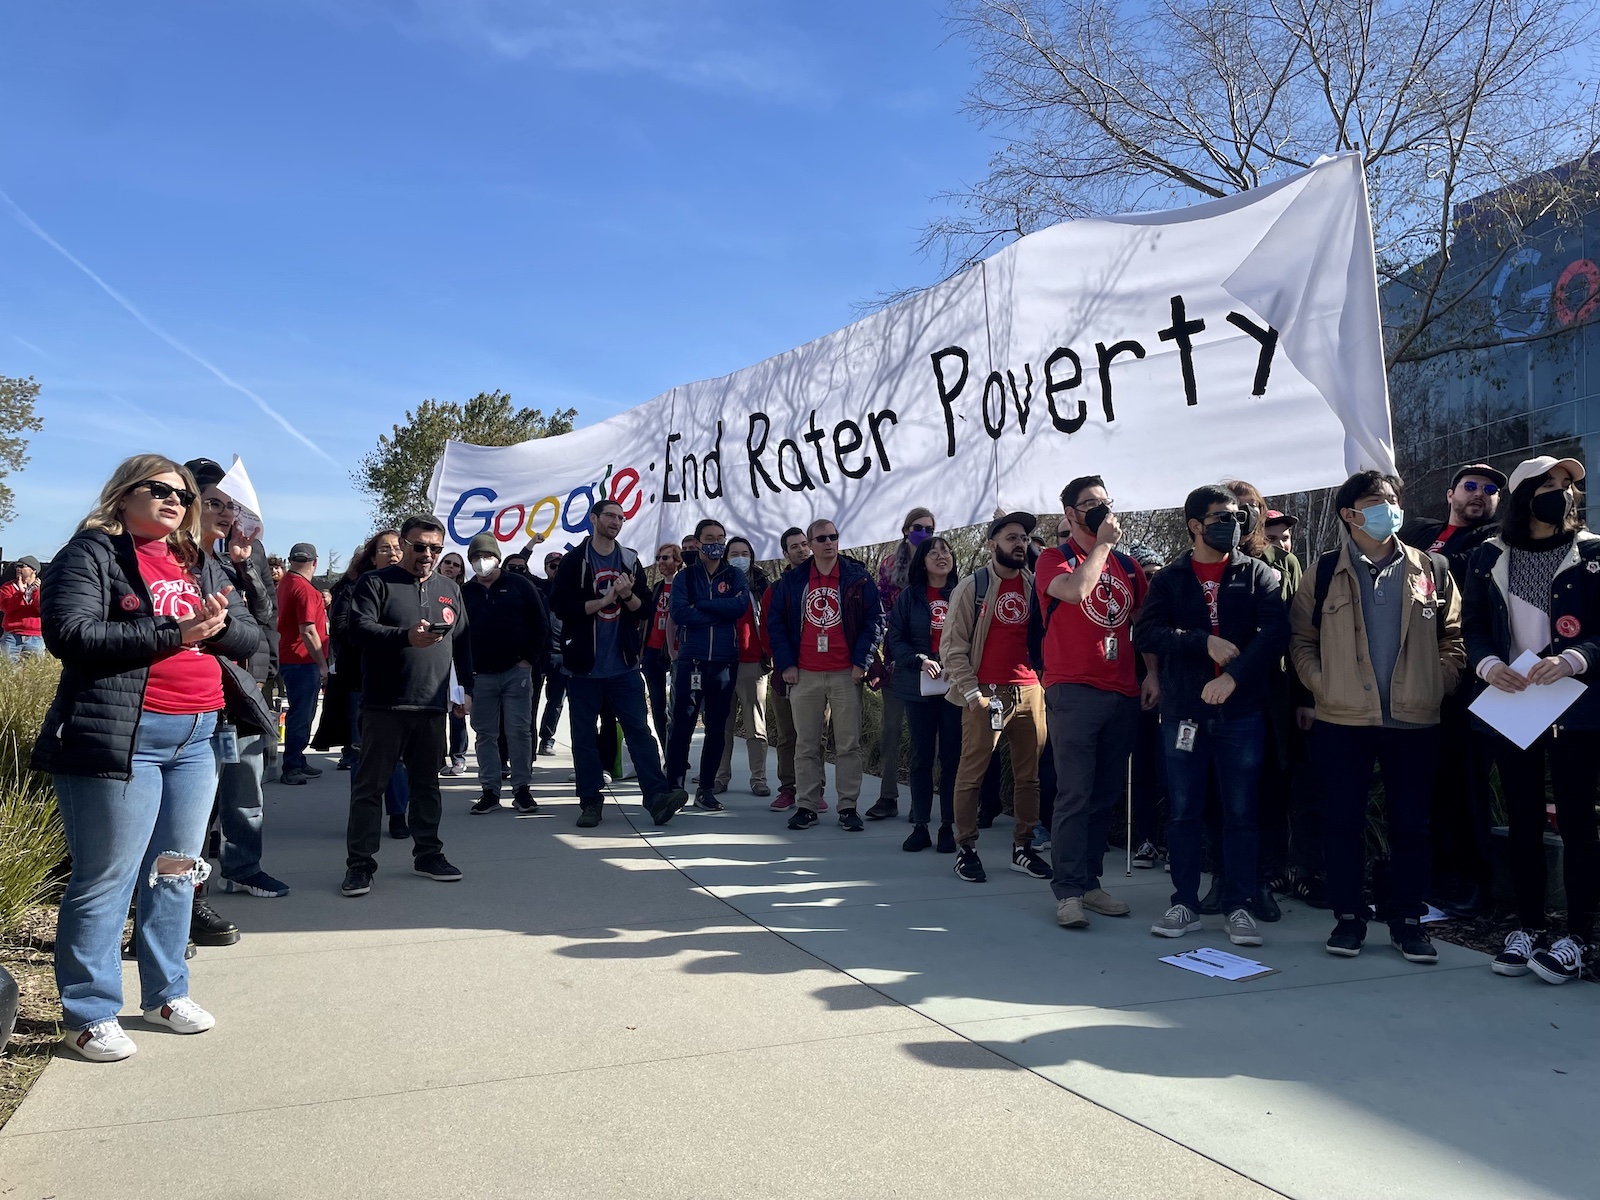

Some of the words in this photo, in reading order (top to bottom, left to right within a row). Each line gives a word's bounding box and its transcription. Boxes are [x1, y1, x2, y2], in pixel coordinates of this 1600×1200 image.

[662, 420, 723, 503] End
[747, 409, 898, 498] Rater
[930, 295, 1279, 457] Poverty
